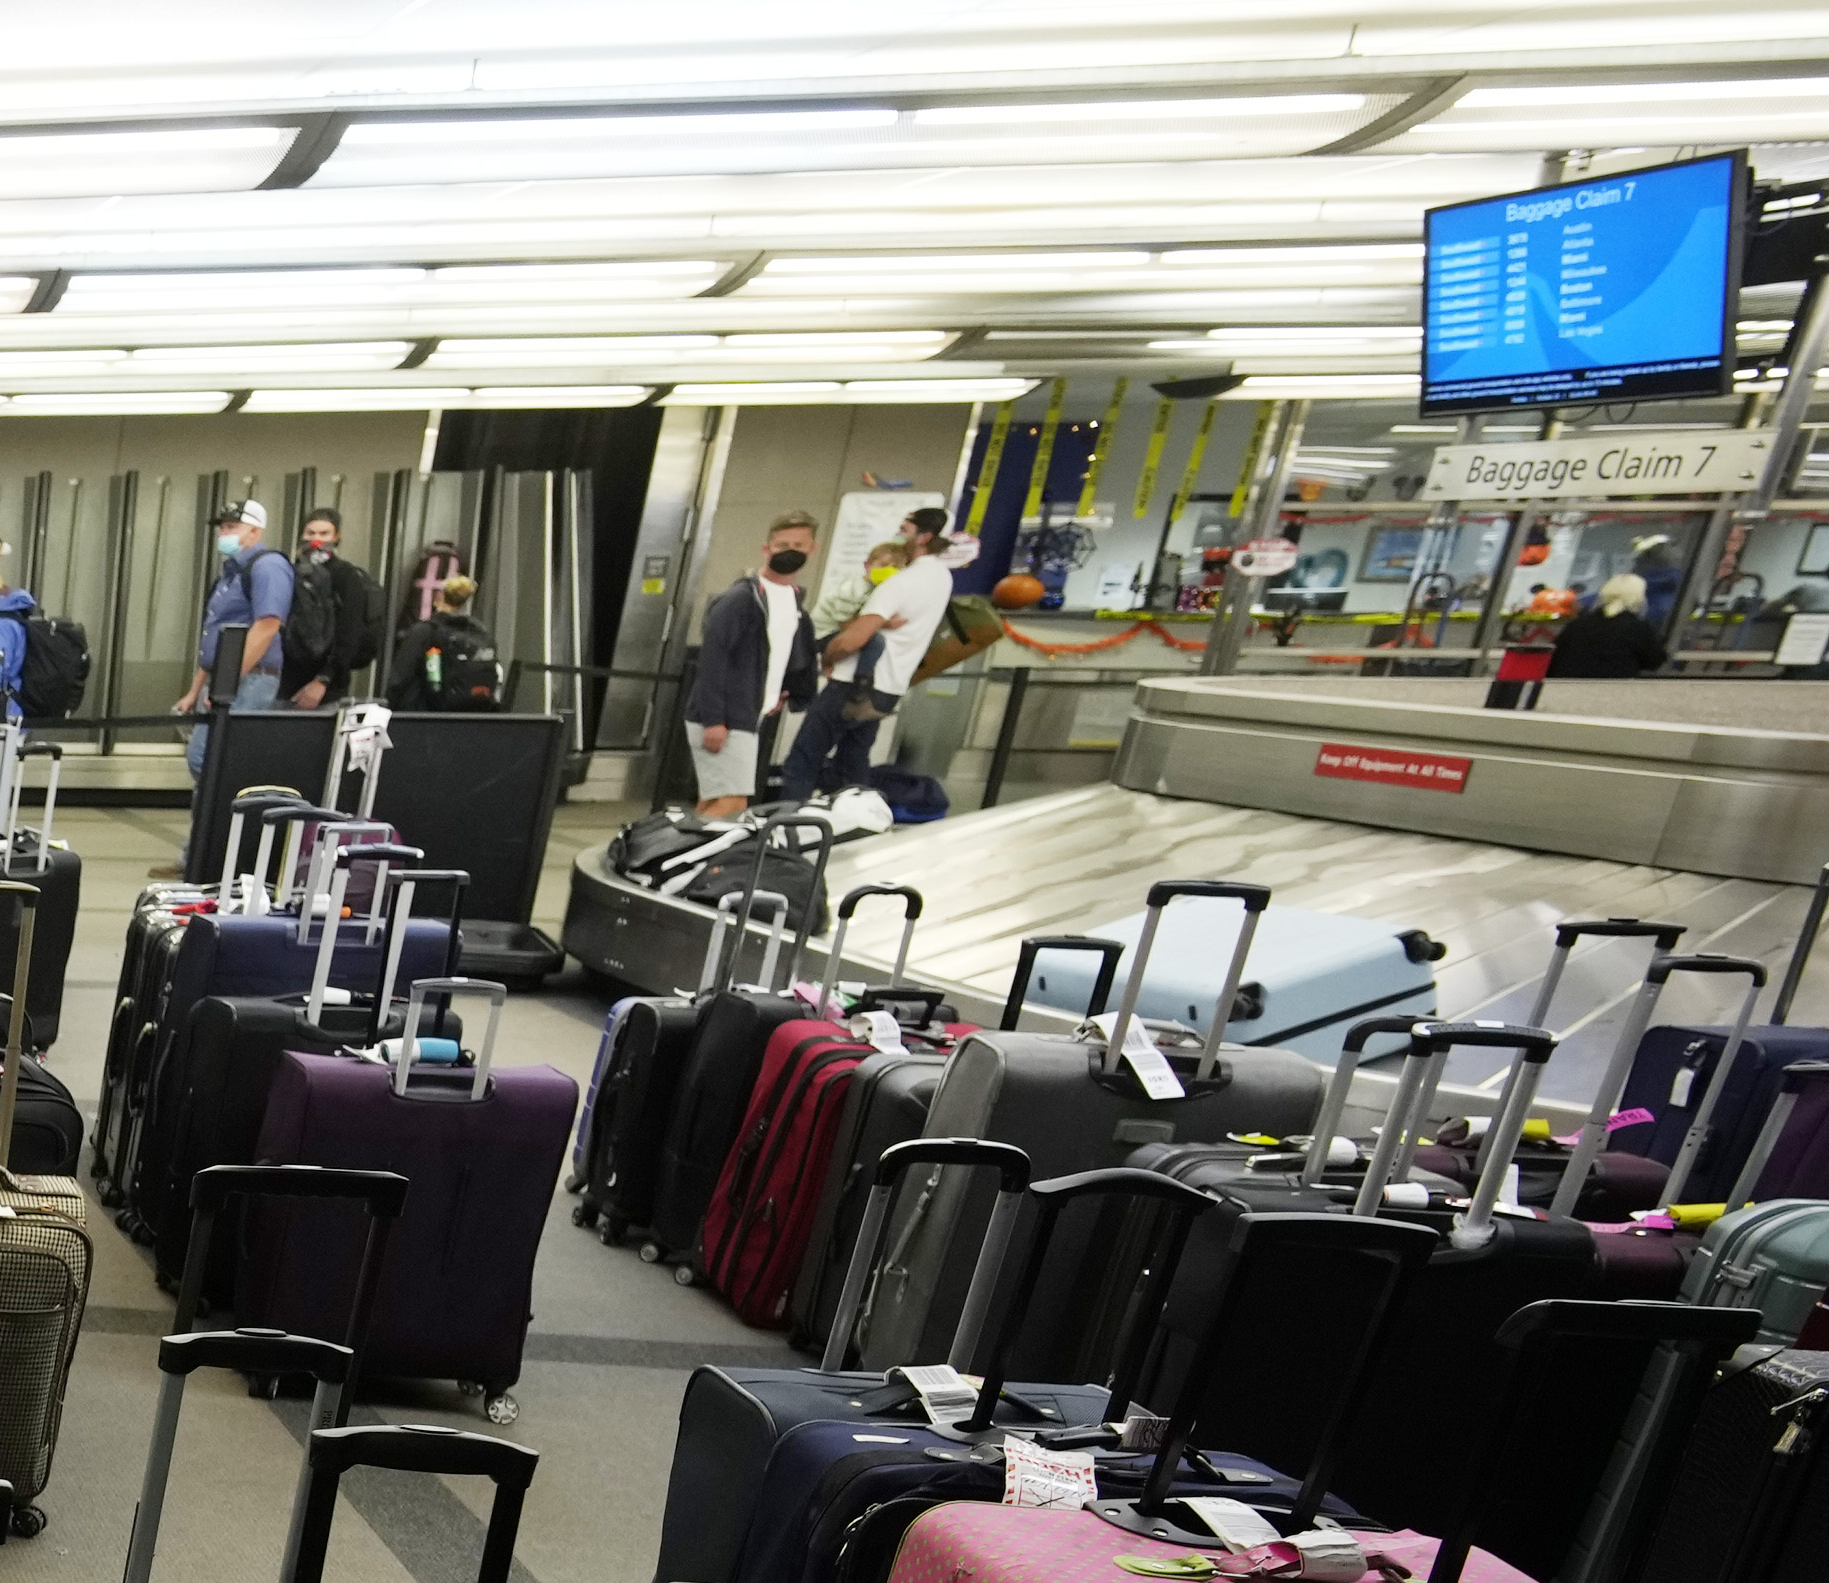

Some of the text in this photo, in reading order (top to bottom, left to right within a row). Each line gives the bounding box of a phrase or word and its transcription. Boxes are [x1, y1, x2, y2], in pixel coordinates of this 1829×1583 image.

[1505, 181, 1637, 223] Baggage Claim 7
[1465, 446, 1718, 490] Baggage Claim 7
[1319, 752, 1342, 768] Keep
[1342, 755, 1360, 768] Off
[1358, 756, 1407, 774] Equipment
[1406, 763, 1420, 775] At
[1435, 765, 1463, 781] Times
